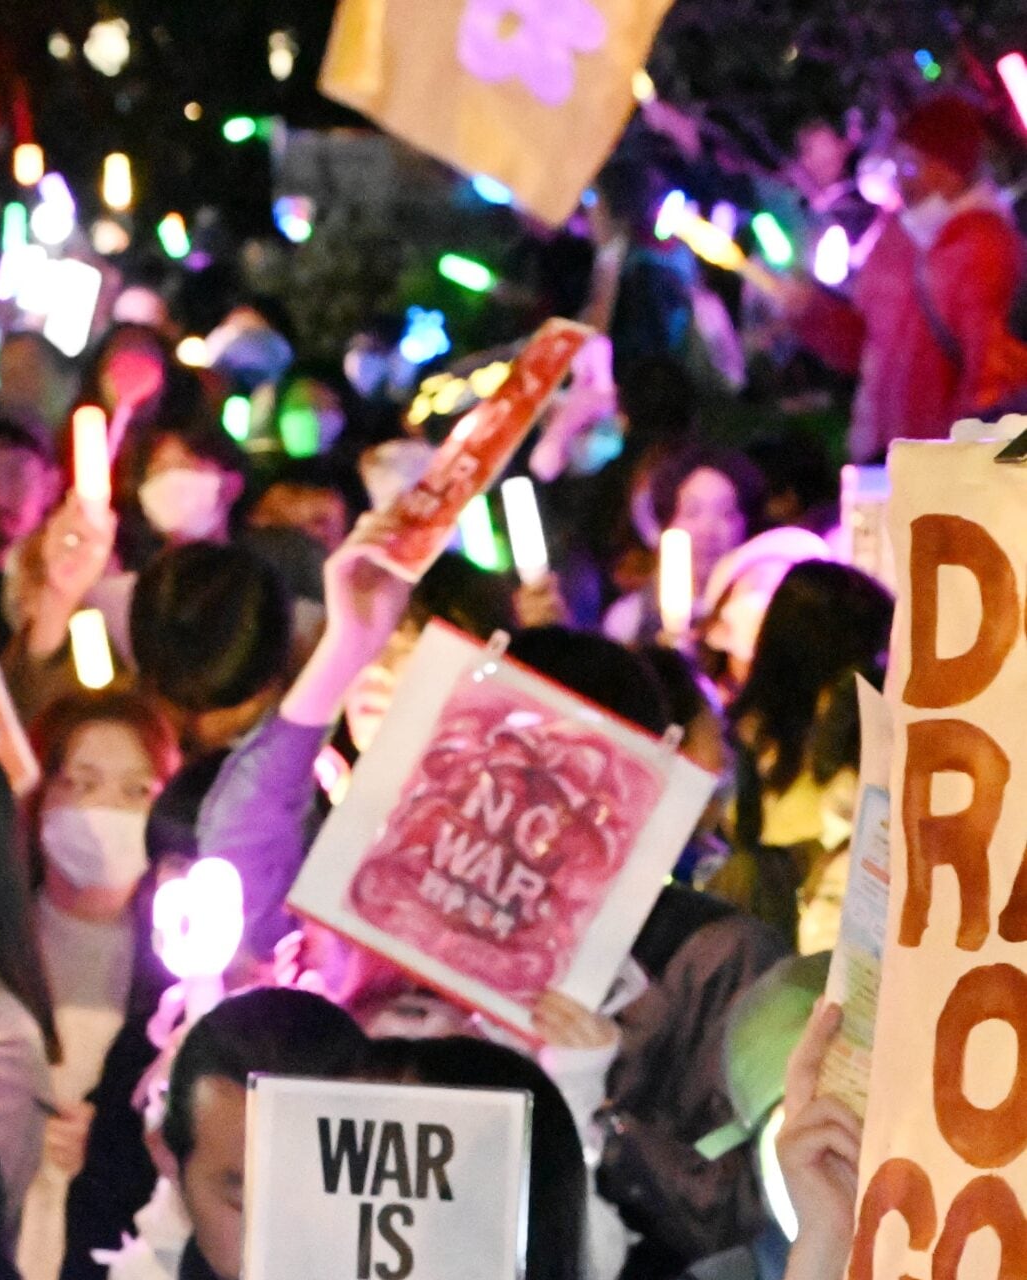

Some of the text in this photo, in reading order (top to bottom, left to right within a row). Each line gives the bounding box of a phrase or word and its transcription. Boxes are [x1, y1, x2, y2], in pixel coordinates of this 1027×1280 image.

[902, 514, 1027, 708] D
[461, 771, 559, 860] NO
[317, 1117, 454, 1201] WAR
